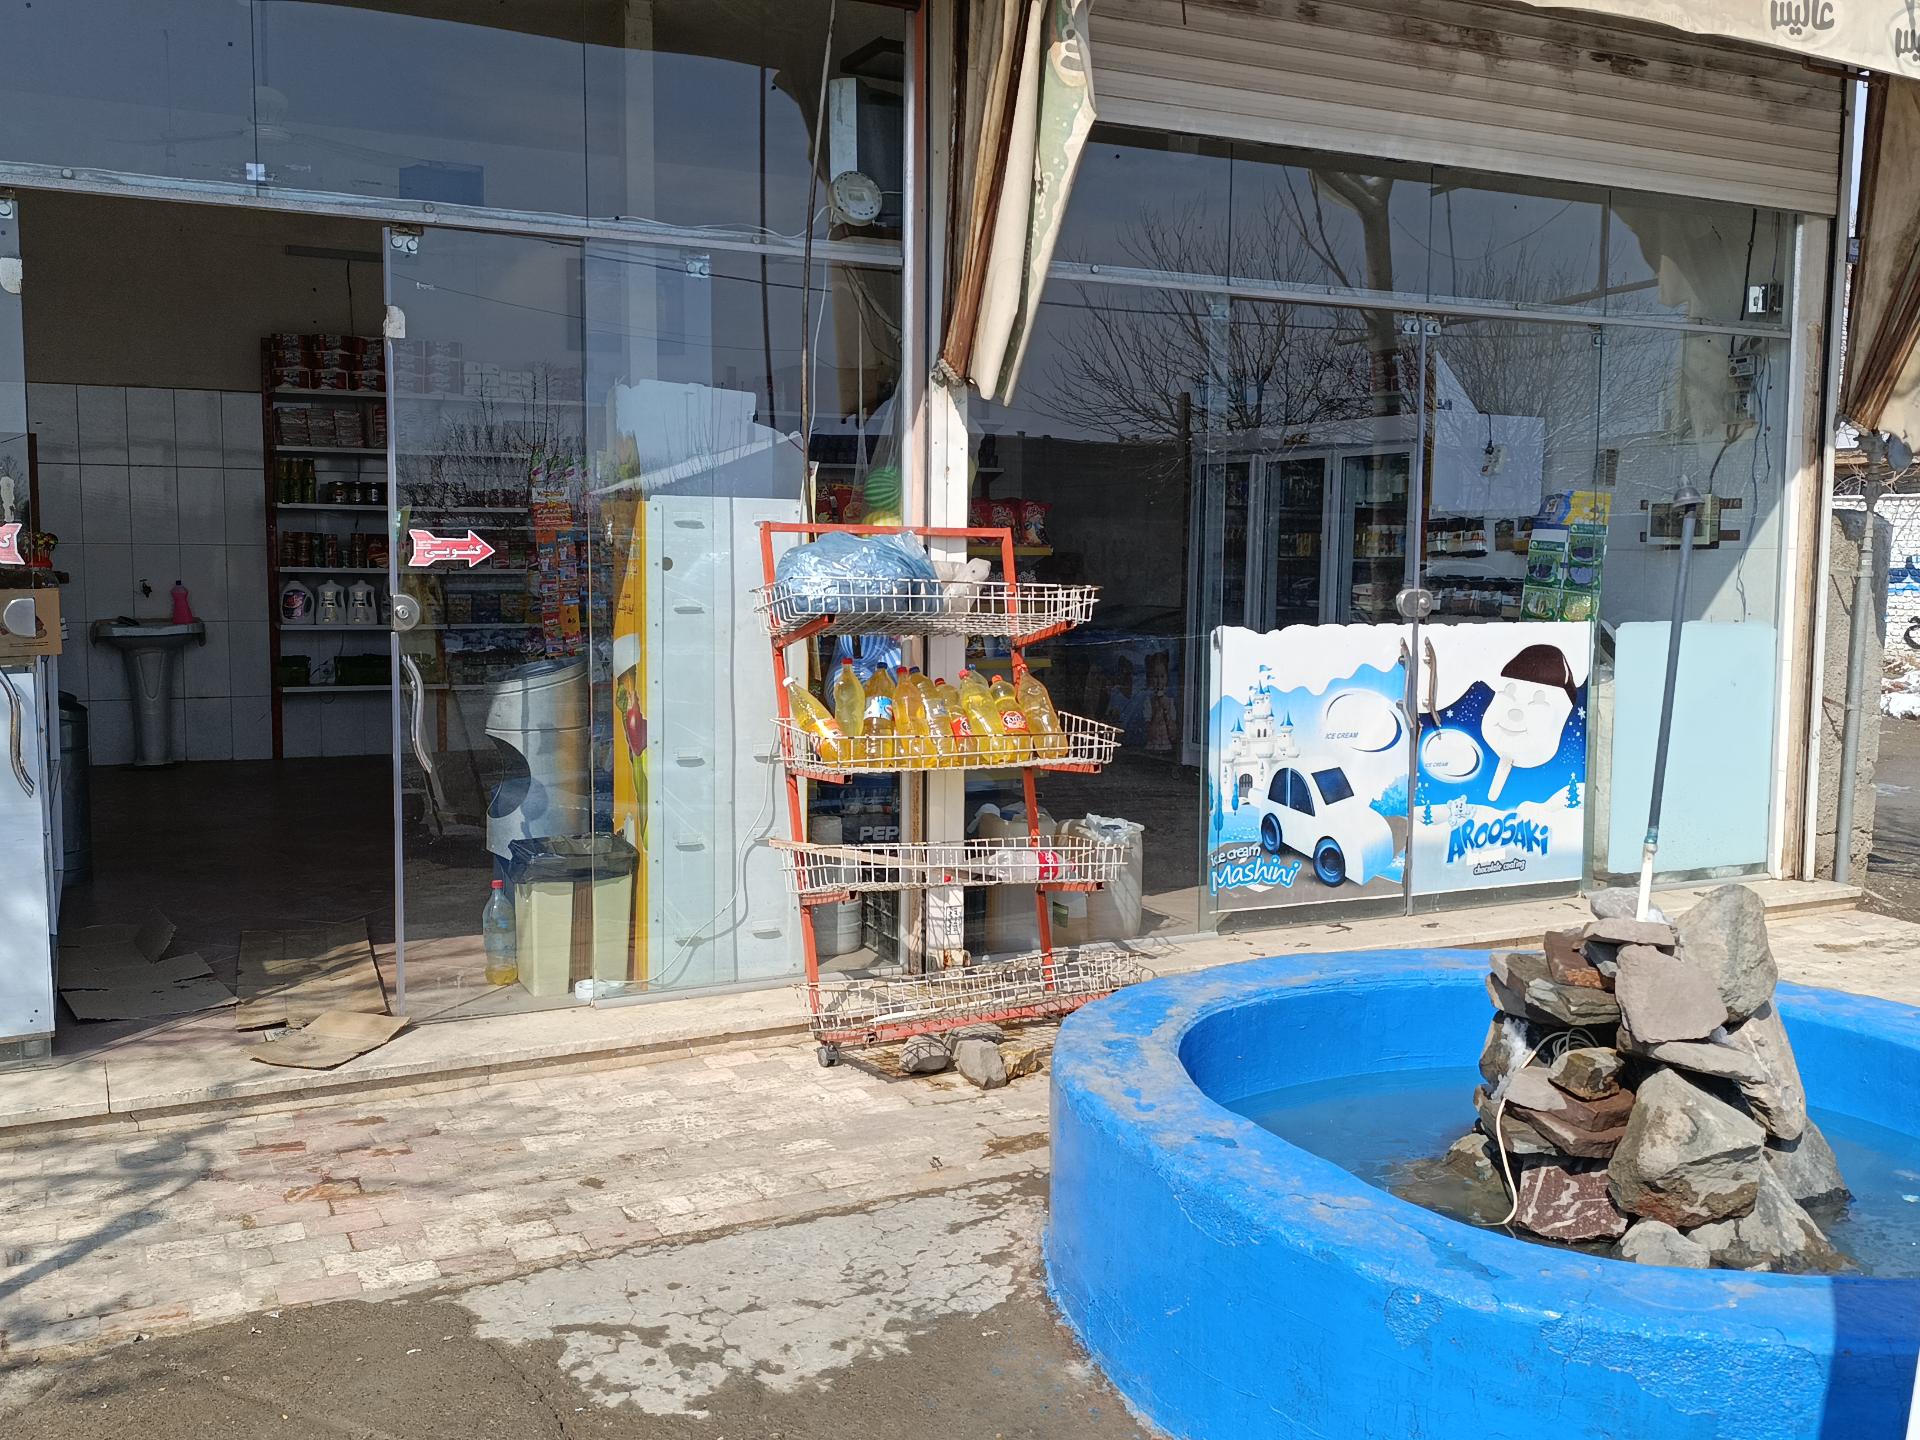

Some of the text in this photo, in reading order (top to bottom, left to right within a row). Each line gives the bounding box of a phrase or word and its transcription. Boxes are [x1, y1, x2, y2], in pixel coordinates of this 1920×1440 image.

[424, 544, 483, 558] کشویی
[1325, 731, 1359, 740] ICE CREAM
[859, 825, 899, 841] PEP
[1227, 846, 1261, 860] cream
[1211, 856, 1299, 892] Mashini
[1473, 861, 1503, 875] chocolate
